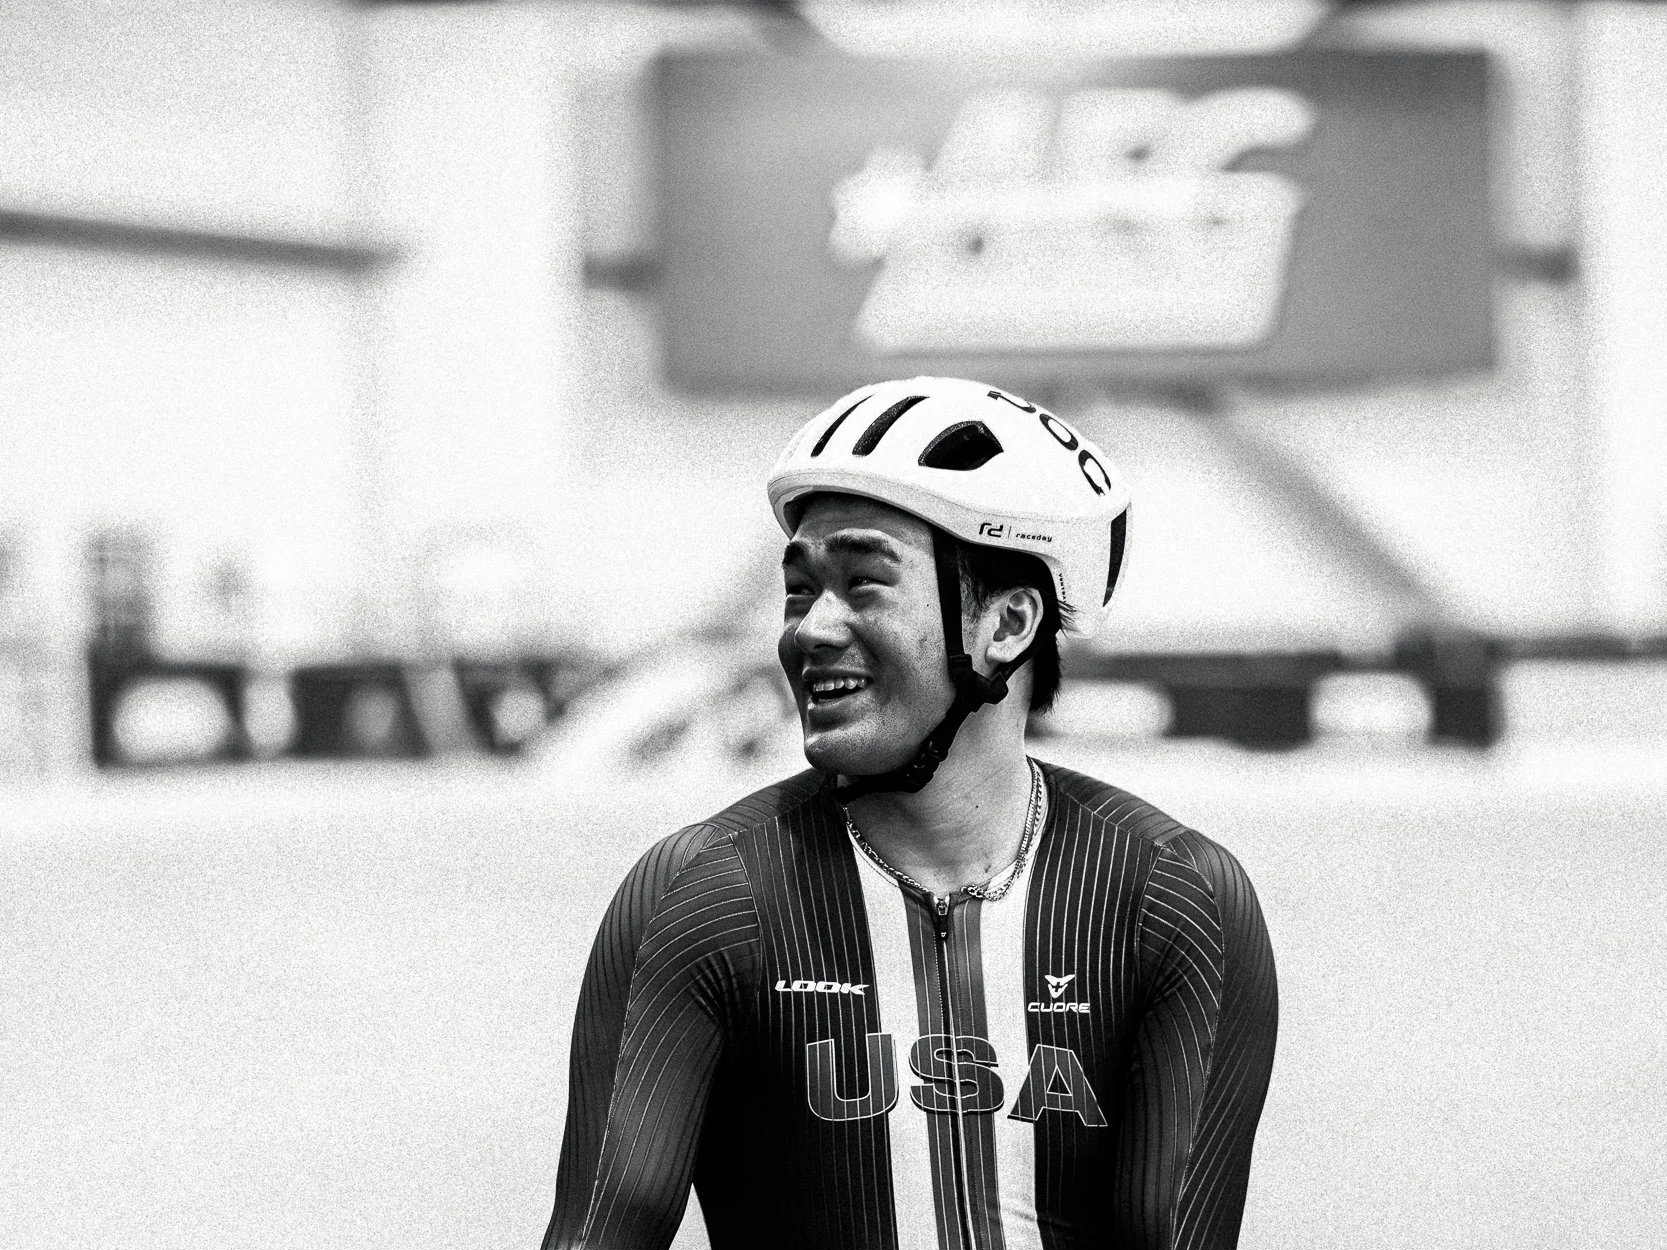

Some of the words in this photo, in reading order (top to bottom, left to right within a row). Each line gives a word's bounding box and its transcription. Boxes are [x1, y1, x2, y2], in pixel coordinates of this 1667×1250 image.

[1015, 533, 1053, 543] raceday
[774, 979, 870, 996] LOOK
[1027, 1001, 1091, 1014] CUORE
[806, 1032, 1108, 1127] USA
